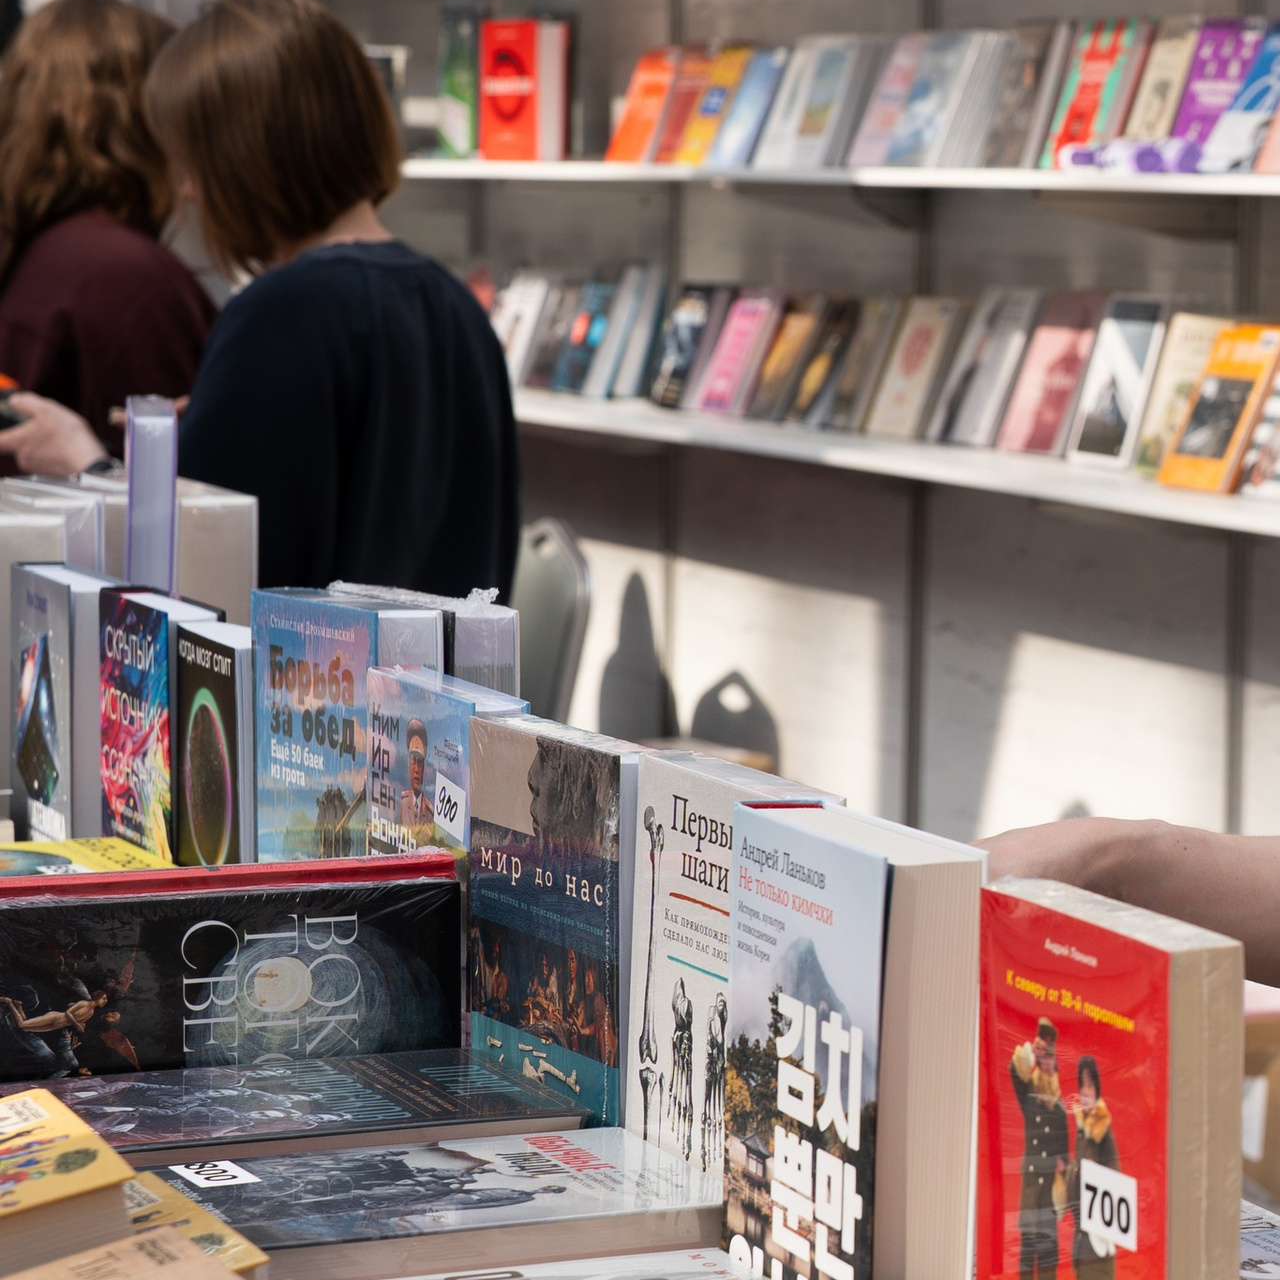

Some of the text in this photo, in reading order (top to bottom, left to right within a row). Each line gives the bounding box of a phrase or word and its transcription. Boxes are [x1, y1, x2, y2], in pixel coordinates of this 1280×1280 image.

[104, 624, 155, 674] СКРЫТЫЙ
[178, 637, 232, 677] КОГДА МОЗГ СПИТ
[269, 644, 355, 708] Борьба
[100, 686, 164, 736] ИСТОЧНИК
[270, 701, 357, 762] за обед
[270, 738, 324, 770] Ещё 50 баек
[270, 763, 306, 787] из грота
[436, 786, 458, 823] 900
[481, 847, 604, 907] мир до нас
[681, 852, 730, 894] шаги
[740, 836, 827, 890] Андрей Ланьков
[738, 865, 834, 926] Не только кимчхи
[681, 917, 730, 945] ПРЯМОХОЖДЕ
[696, 941, 710, 954] НАС
[181, 919, 239, 1066] СВЕ
[243, 913, 301, 1065] ТОГ
[1006, 970, 1014, 985] К
[1048, 989, 1059, 1003] от
[1060, 989, 1082, 1012] 38-й
[420, 1064, 521, 1097] ОТРЯД
[775, 992, 864, 1152] 김치
[184, 1162, 238, 1182] 800
[498, 1151, 571, 1176] ЛЮДИ
[522, 1135, 617, 1173] ОБЫЧНЫЕ
[1085, 1182, 1130, 1234] 700
